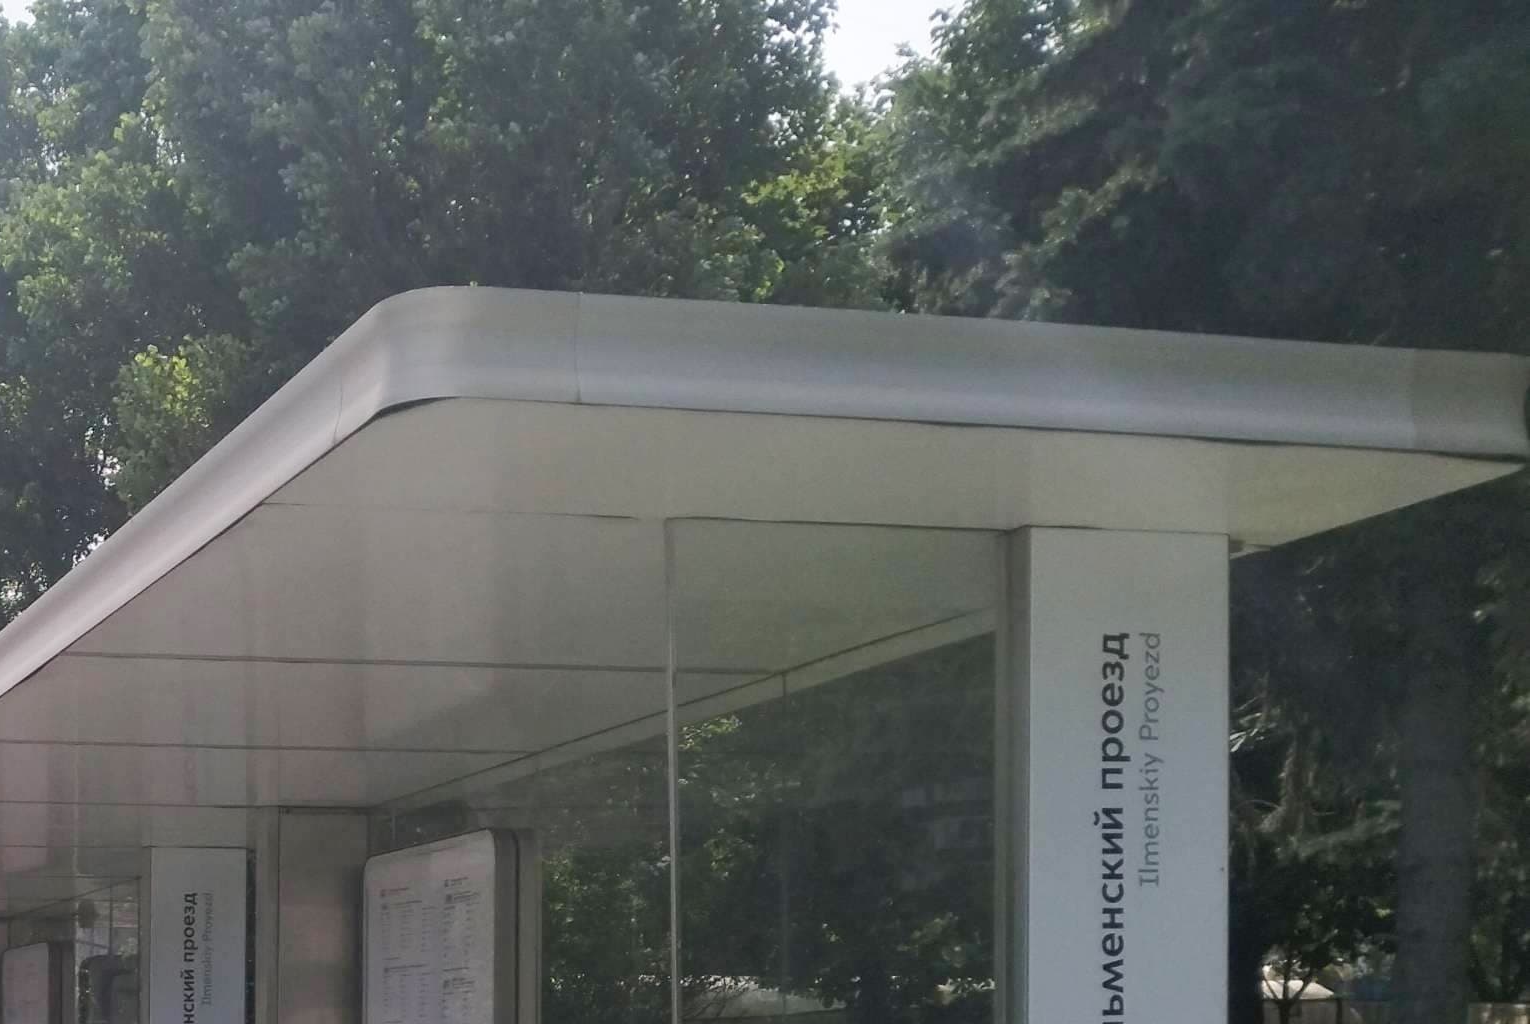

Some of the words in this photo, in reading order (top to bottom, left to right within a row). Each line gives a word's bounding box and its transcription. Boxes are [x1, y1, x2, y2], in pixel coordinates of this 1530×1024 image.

[1101, 632, 1131, 790] проезд
[1138, 631, 1165, 741] Proyezd
[1138, 752, 1165, 887] Ilmenskiy
[183, 892, 198, 962] проезд
